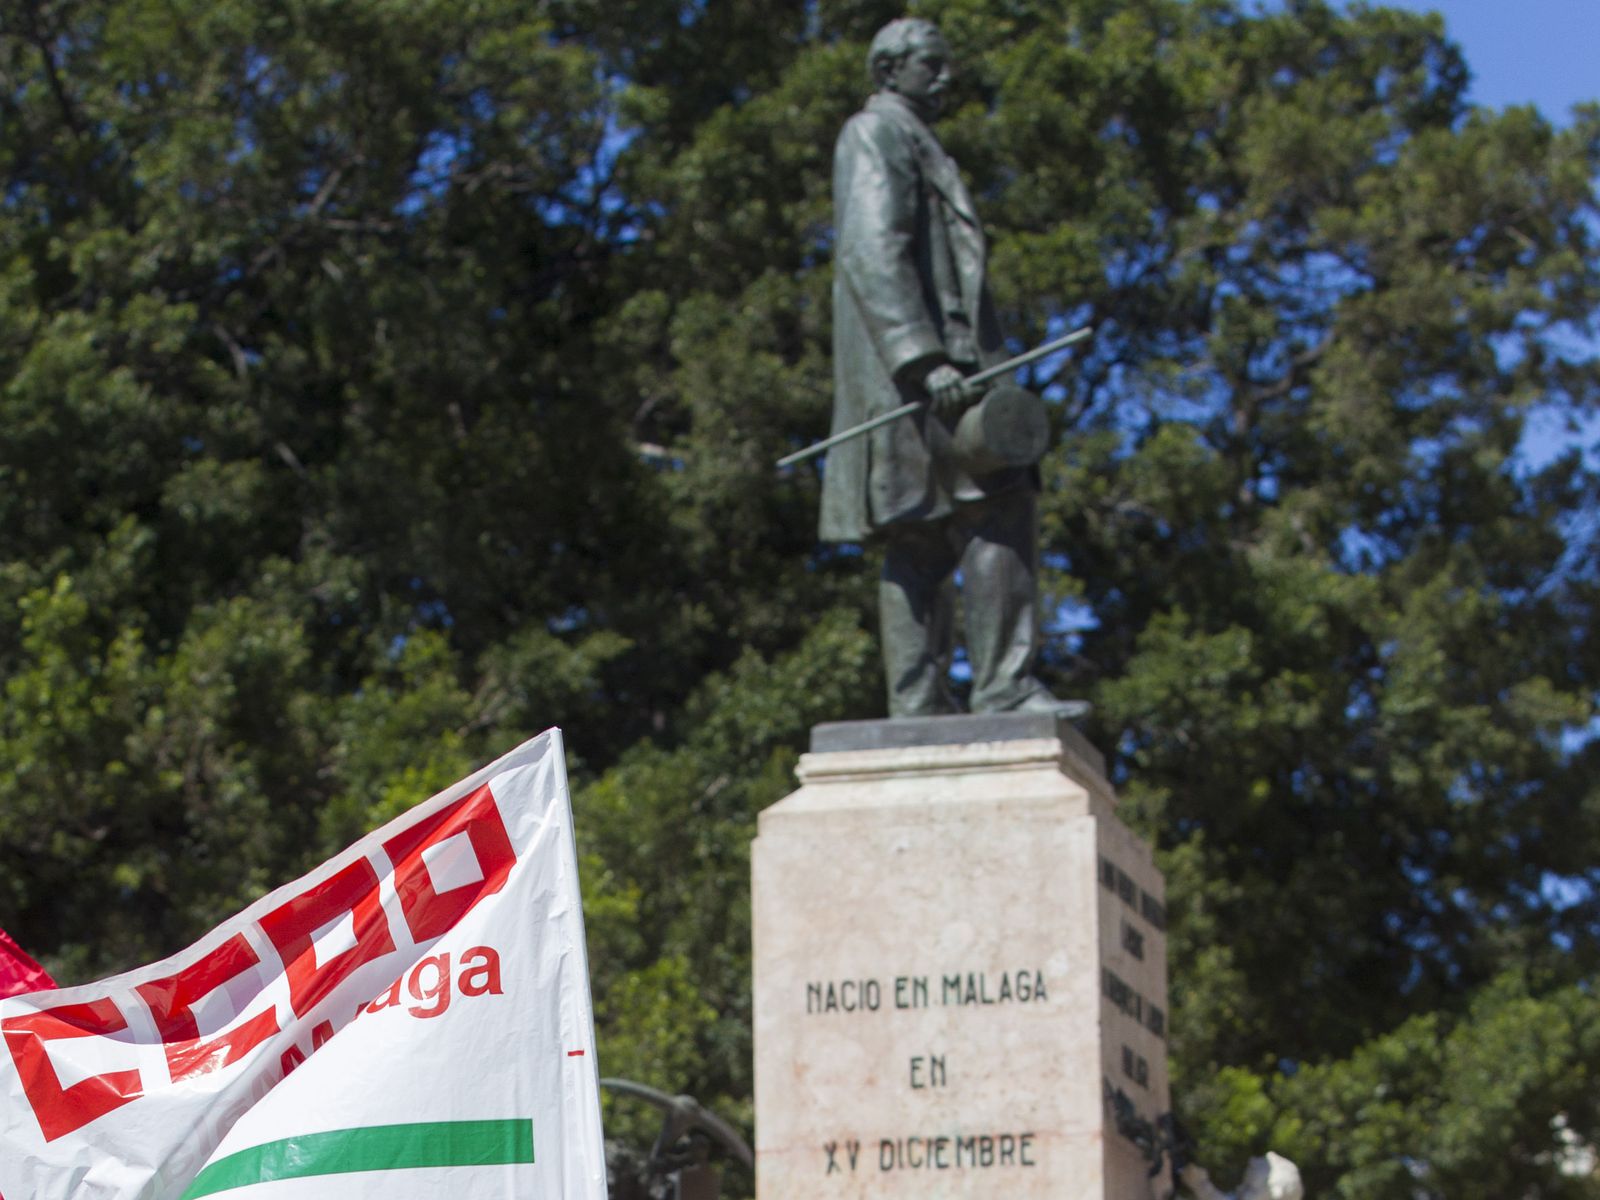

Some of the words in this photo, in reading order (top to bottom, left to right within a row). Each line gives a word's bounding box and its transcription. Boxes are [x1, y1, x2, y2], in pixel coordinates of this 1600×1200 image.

[806, 979, 881, 1014] NACIO
[895, 976, 929, 1009] EN
[942, 970, 1047, 1006] MALAGA
[910, 1055, 947, 1089] EN
[823, 1139, 860, 1175] XV
[879, 1132, 1036, 1172] DICIEMBRE
